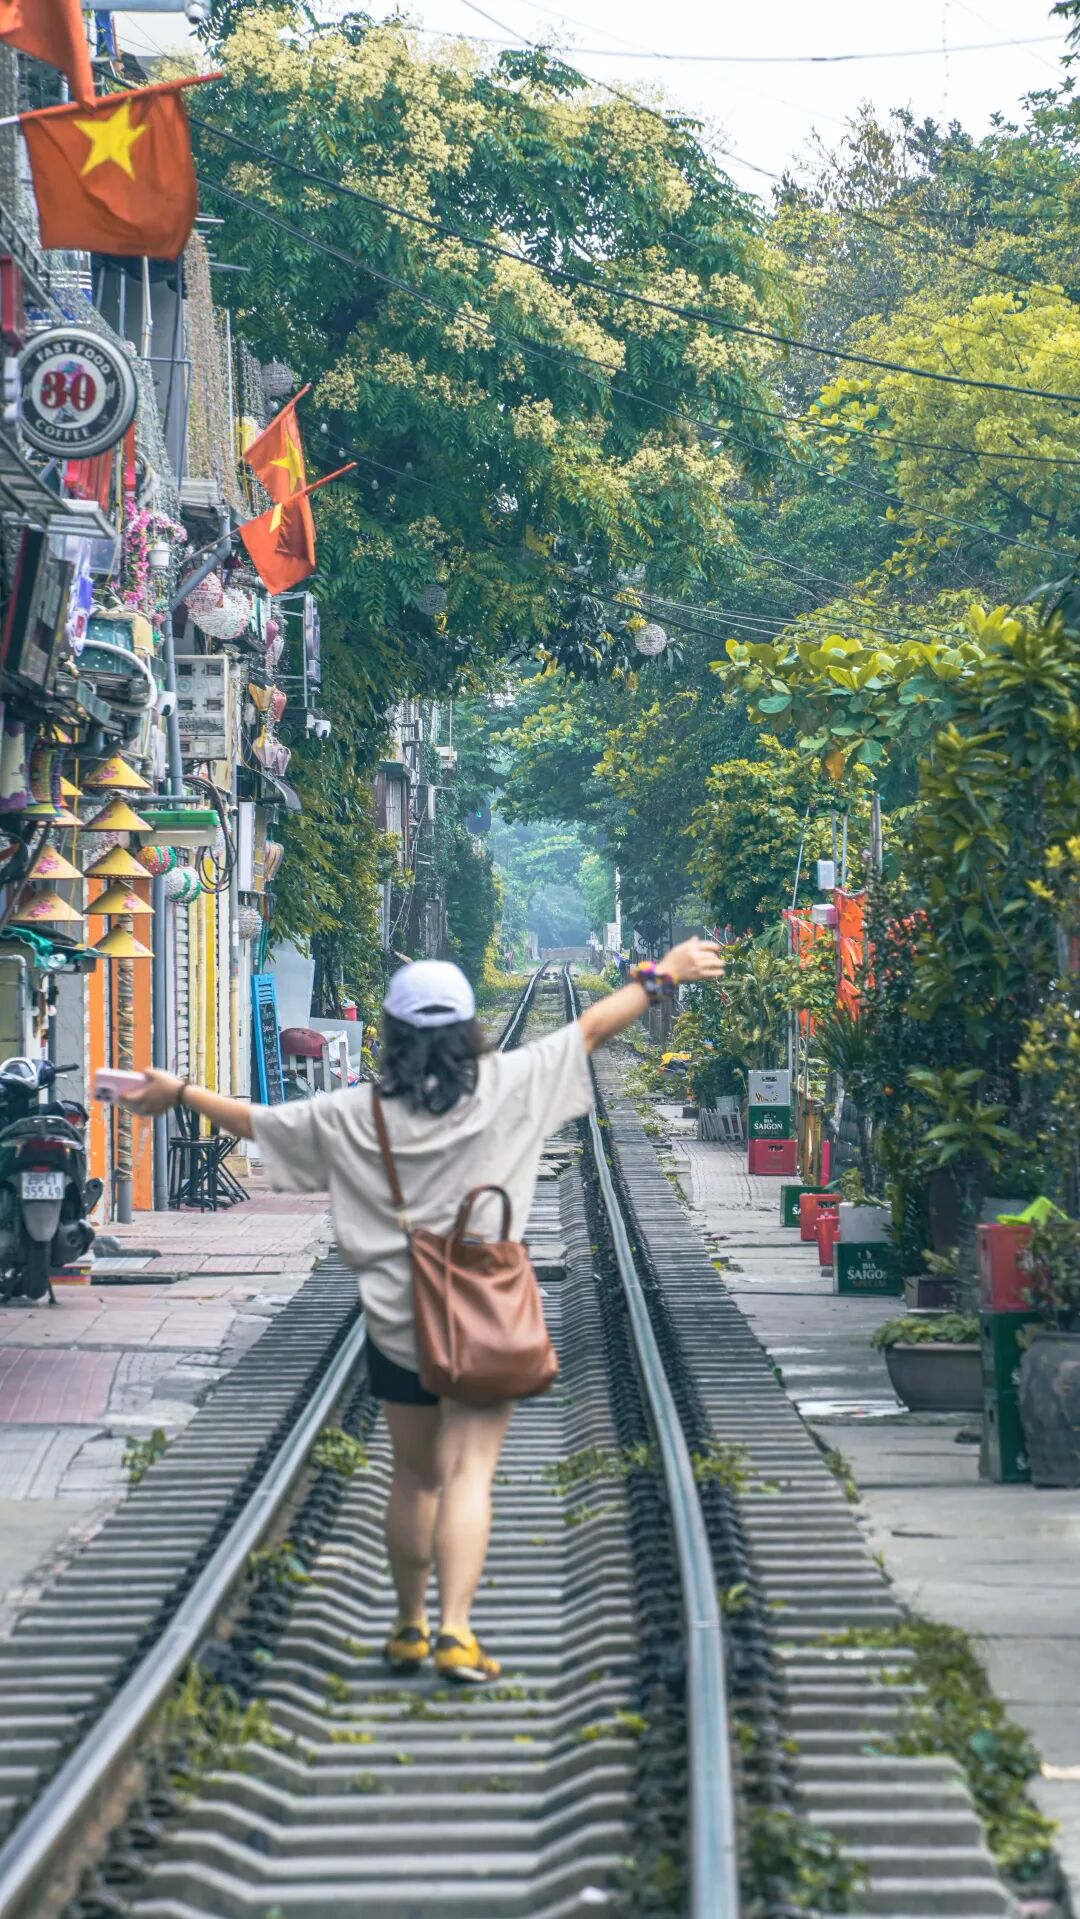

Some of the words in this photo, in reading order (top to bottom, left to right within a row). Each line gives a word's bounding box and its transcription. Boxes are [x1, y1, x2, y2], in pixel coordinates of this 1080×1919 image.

[36, 342, 72, 362] FAST
[76, 344, 111, 374] FOOD
[40, 371, 97, 412] 30
[35, 419, 90, 440] COFFEE
